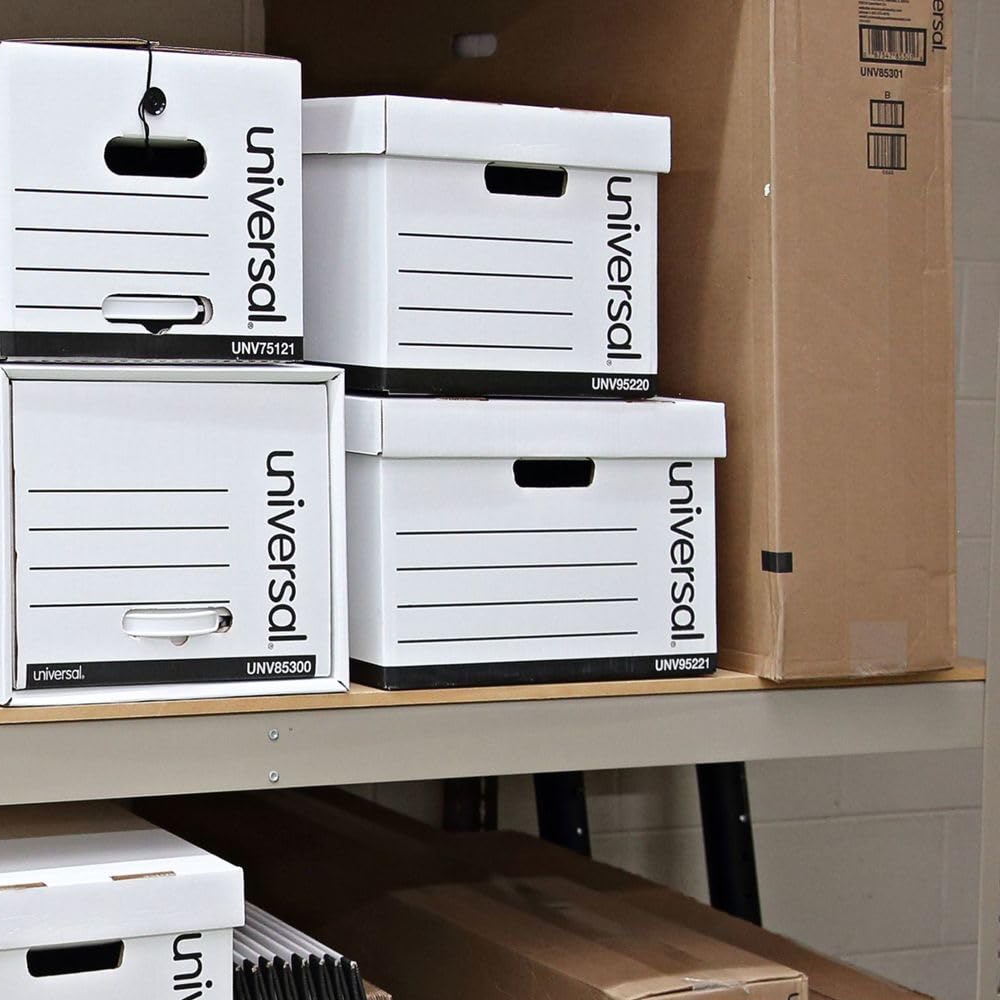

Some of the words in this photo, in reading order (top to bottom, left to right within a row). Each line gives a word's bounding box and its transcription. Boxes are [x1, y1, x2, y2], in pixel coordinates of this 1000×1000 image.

[932, 0, 947, 50] ersal
[860, 67, 903, 78] UNV85301
[246, 126, 287, 322] universal
[606, 175, 642, 360] universal
[231, 341, 294, 356] UNV75121
[591, 377, 650, 391] UNV95220
[266, 450, 308, 641] universal
[668, 461, 705, 641] universal
[32, 664, 82, 682] universal
[246, 660, 311, 676] UNV85300
[655, 657, 710, 672] UNV95221
